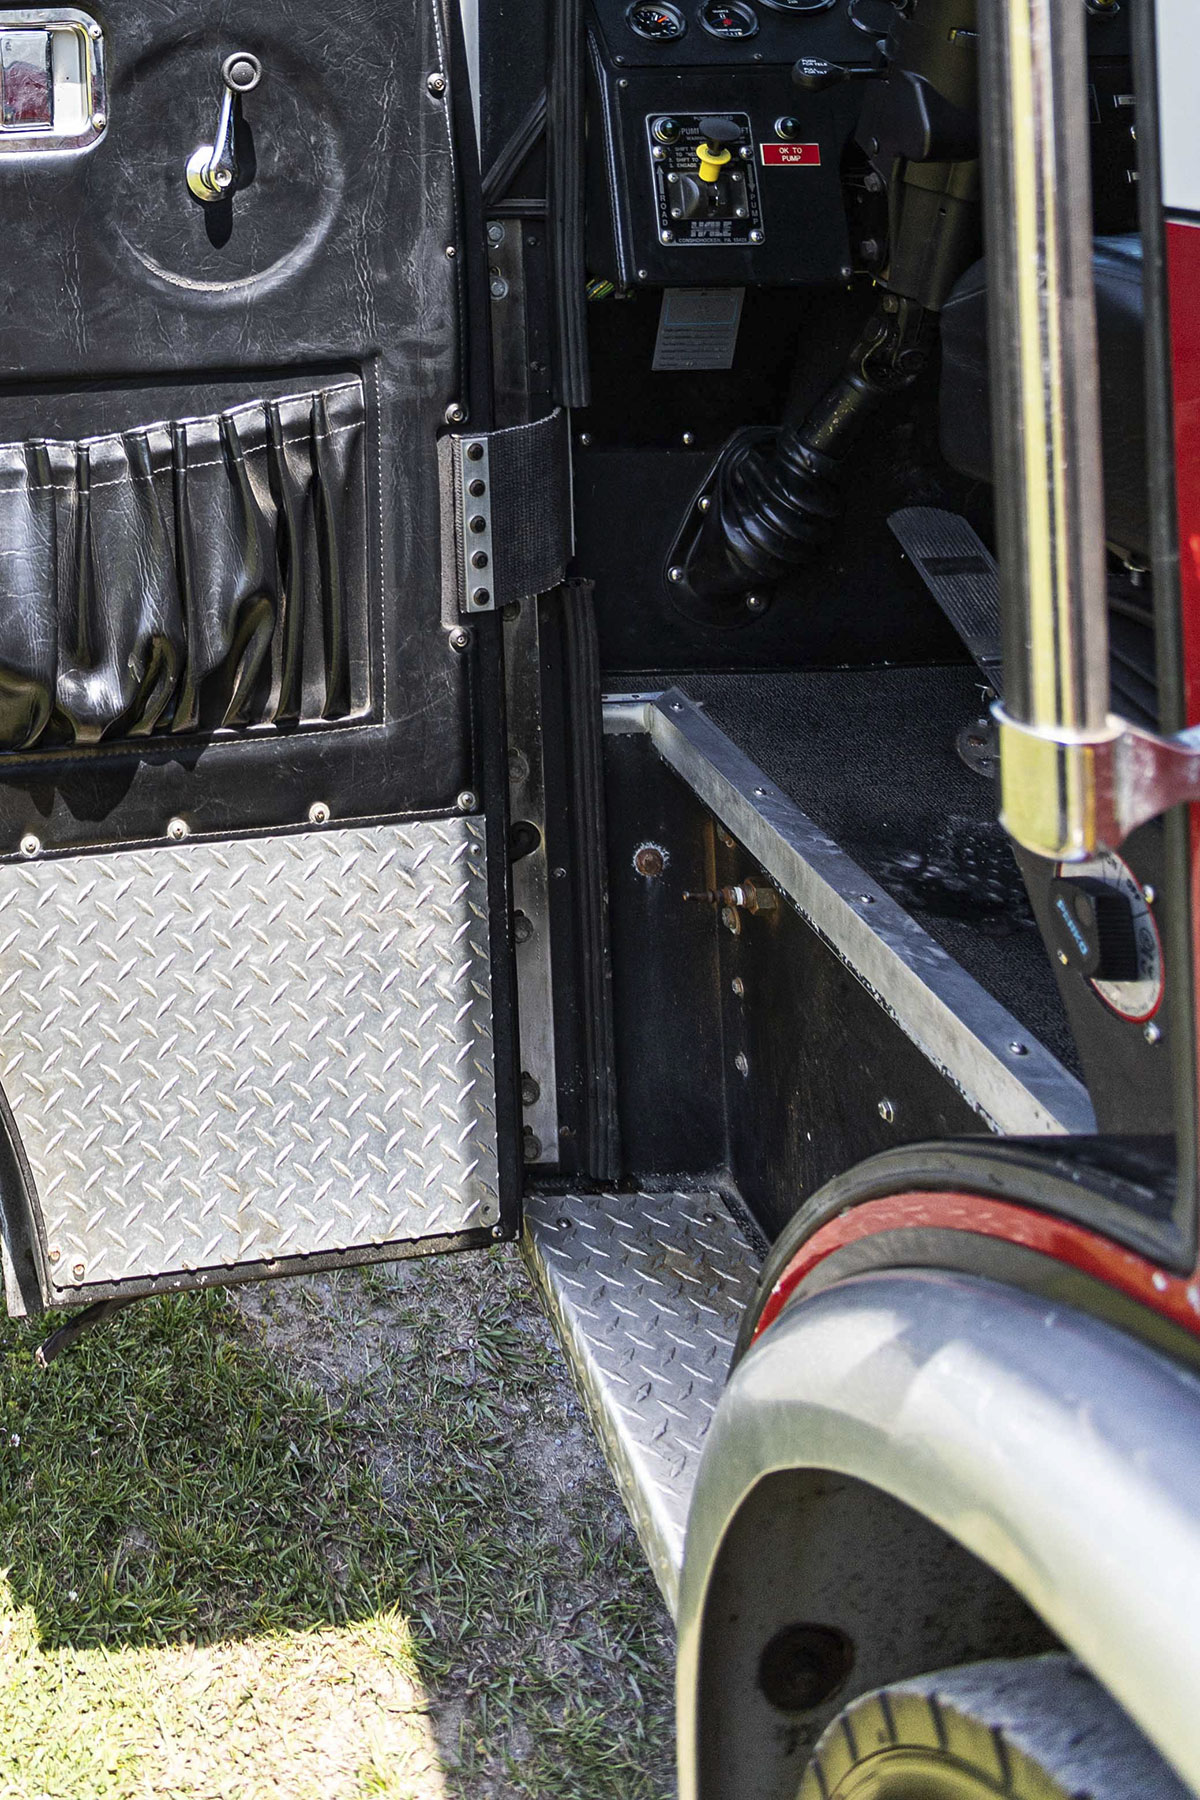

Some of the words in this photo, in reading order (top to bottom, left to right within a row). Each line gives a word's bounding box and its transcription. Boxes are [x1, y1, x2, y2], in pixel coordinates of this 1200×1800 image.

[660, 194, 668, 226] ROAD
[750, 194, 759, 224] PUMP
[690, 221, 732, 237] HALE
